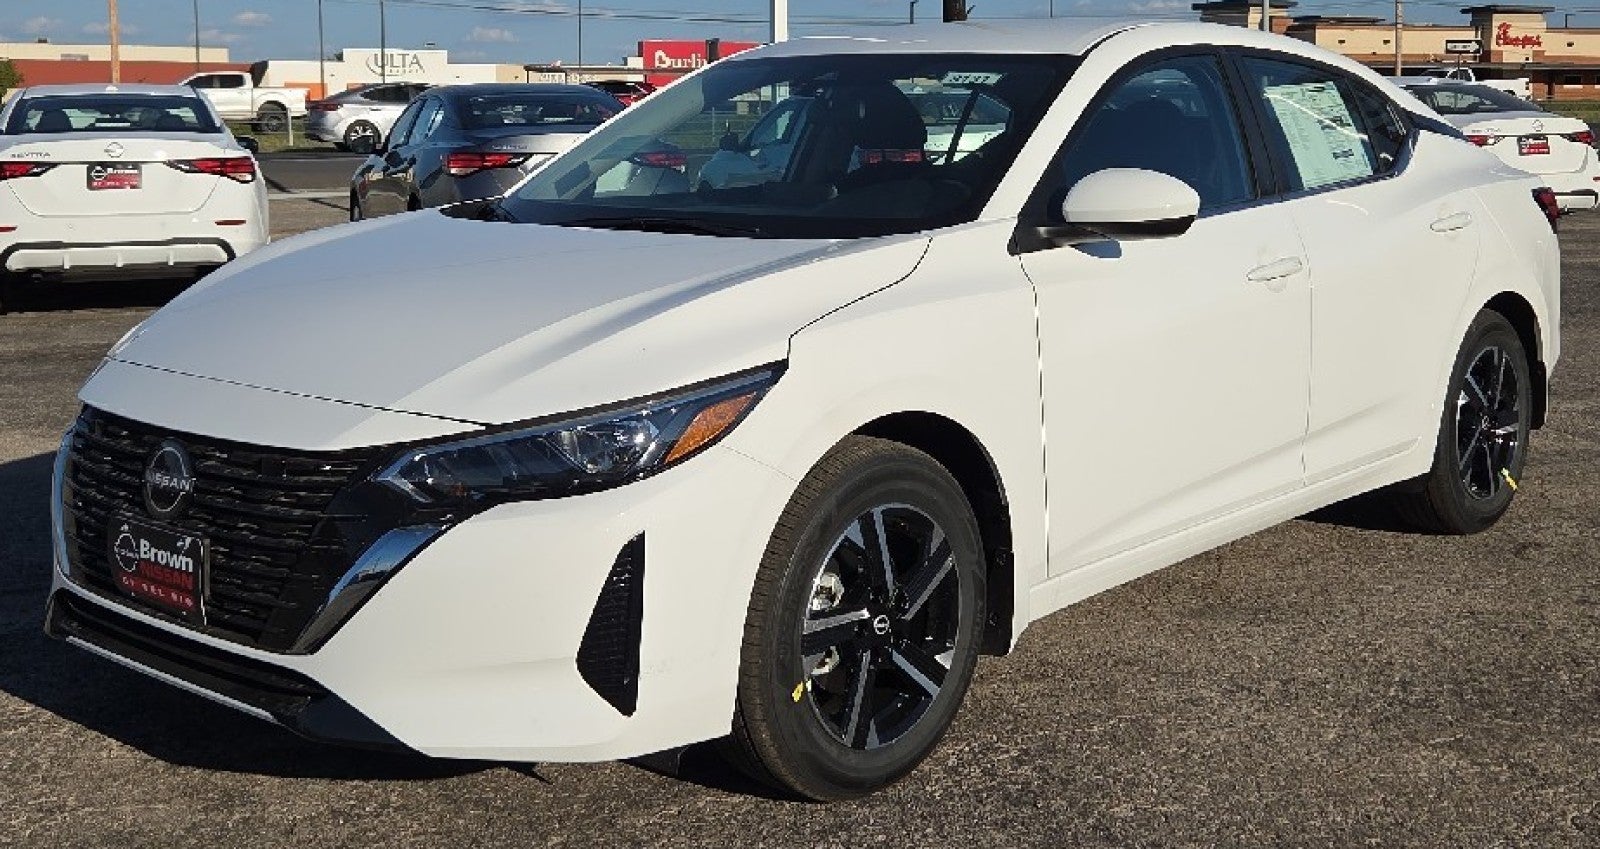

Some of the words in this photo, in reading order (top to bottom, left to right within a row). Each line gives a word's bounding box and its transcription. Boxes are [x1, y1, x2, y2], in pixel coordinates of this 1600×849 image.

[374, 53, 424, 69] ULTA
[140, 538, 193, 572] Brown
[140, 559, 193, 590] NISSAN
